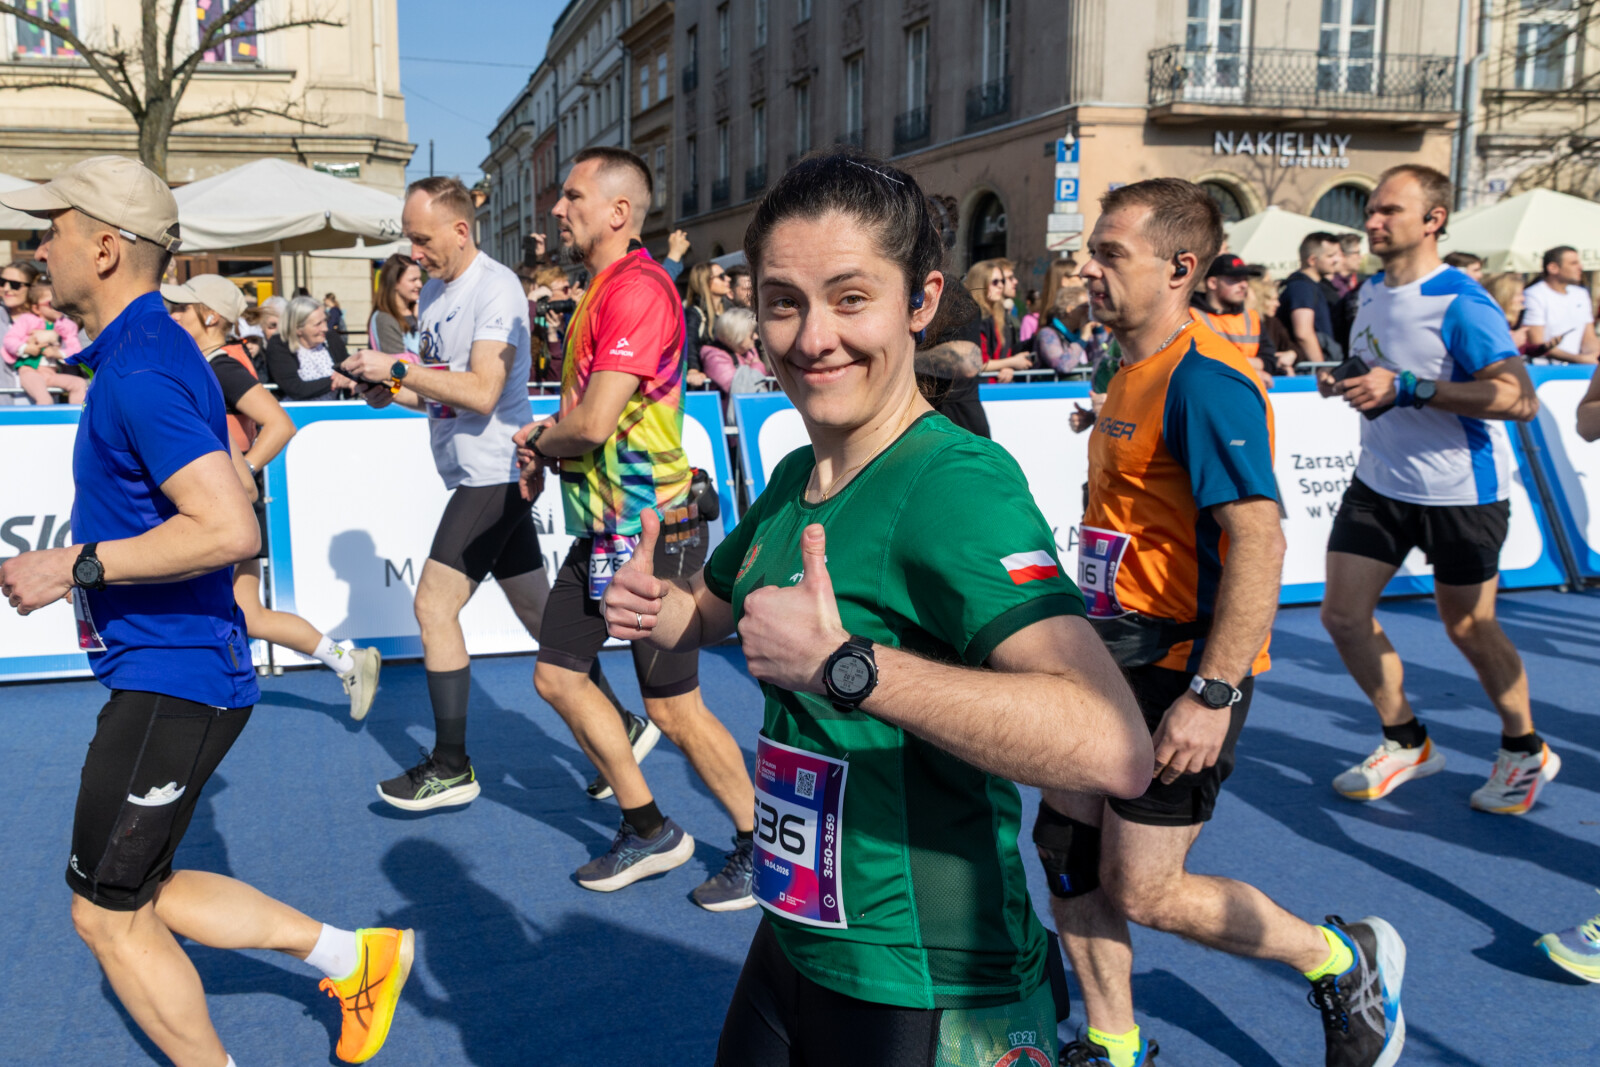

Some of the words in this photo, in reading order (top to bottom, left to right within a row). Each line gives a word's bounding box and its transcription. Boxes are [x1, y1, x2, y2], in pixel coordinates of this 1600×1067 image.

[1214, 130, 1352, 156] NAKIELNY
[1060, 180, 1075, 199] P
[1291, 450, 1356, 472] Zarząd
[823, 813, 836, 879] 3:50-3:59
[764, 858, 790, 877] 19.04.2026
[1008, 1030, 1037, 1046] 1921
